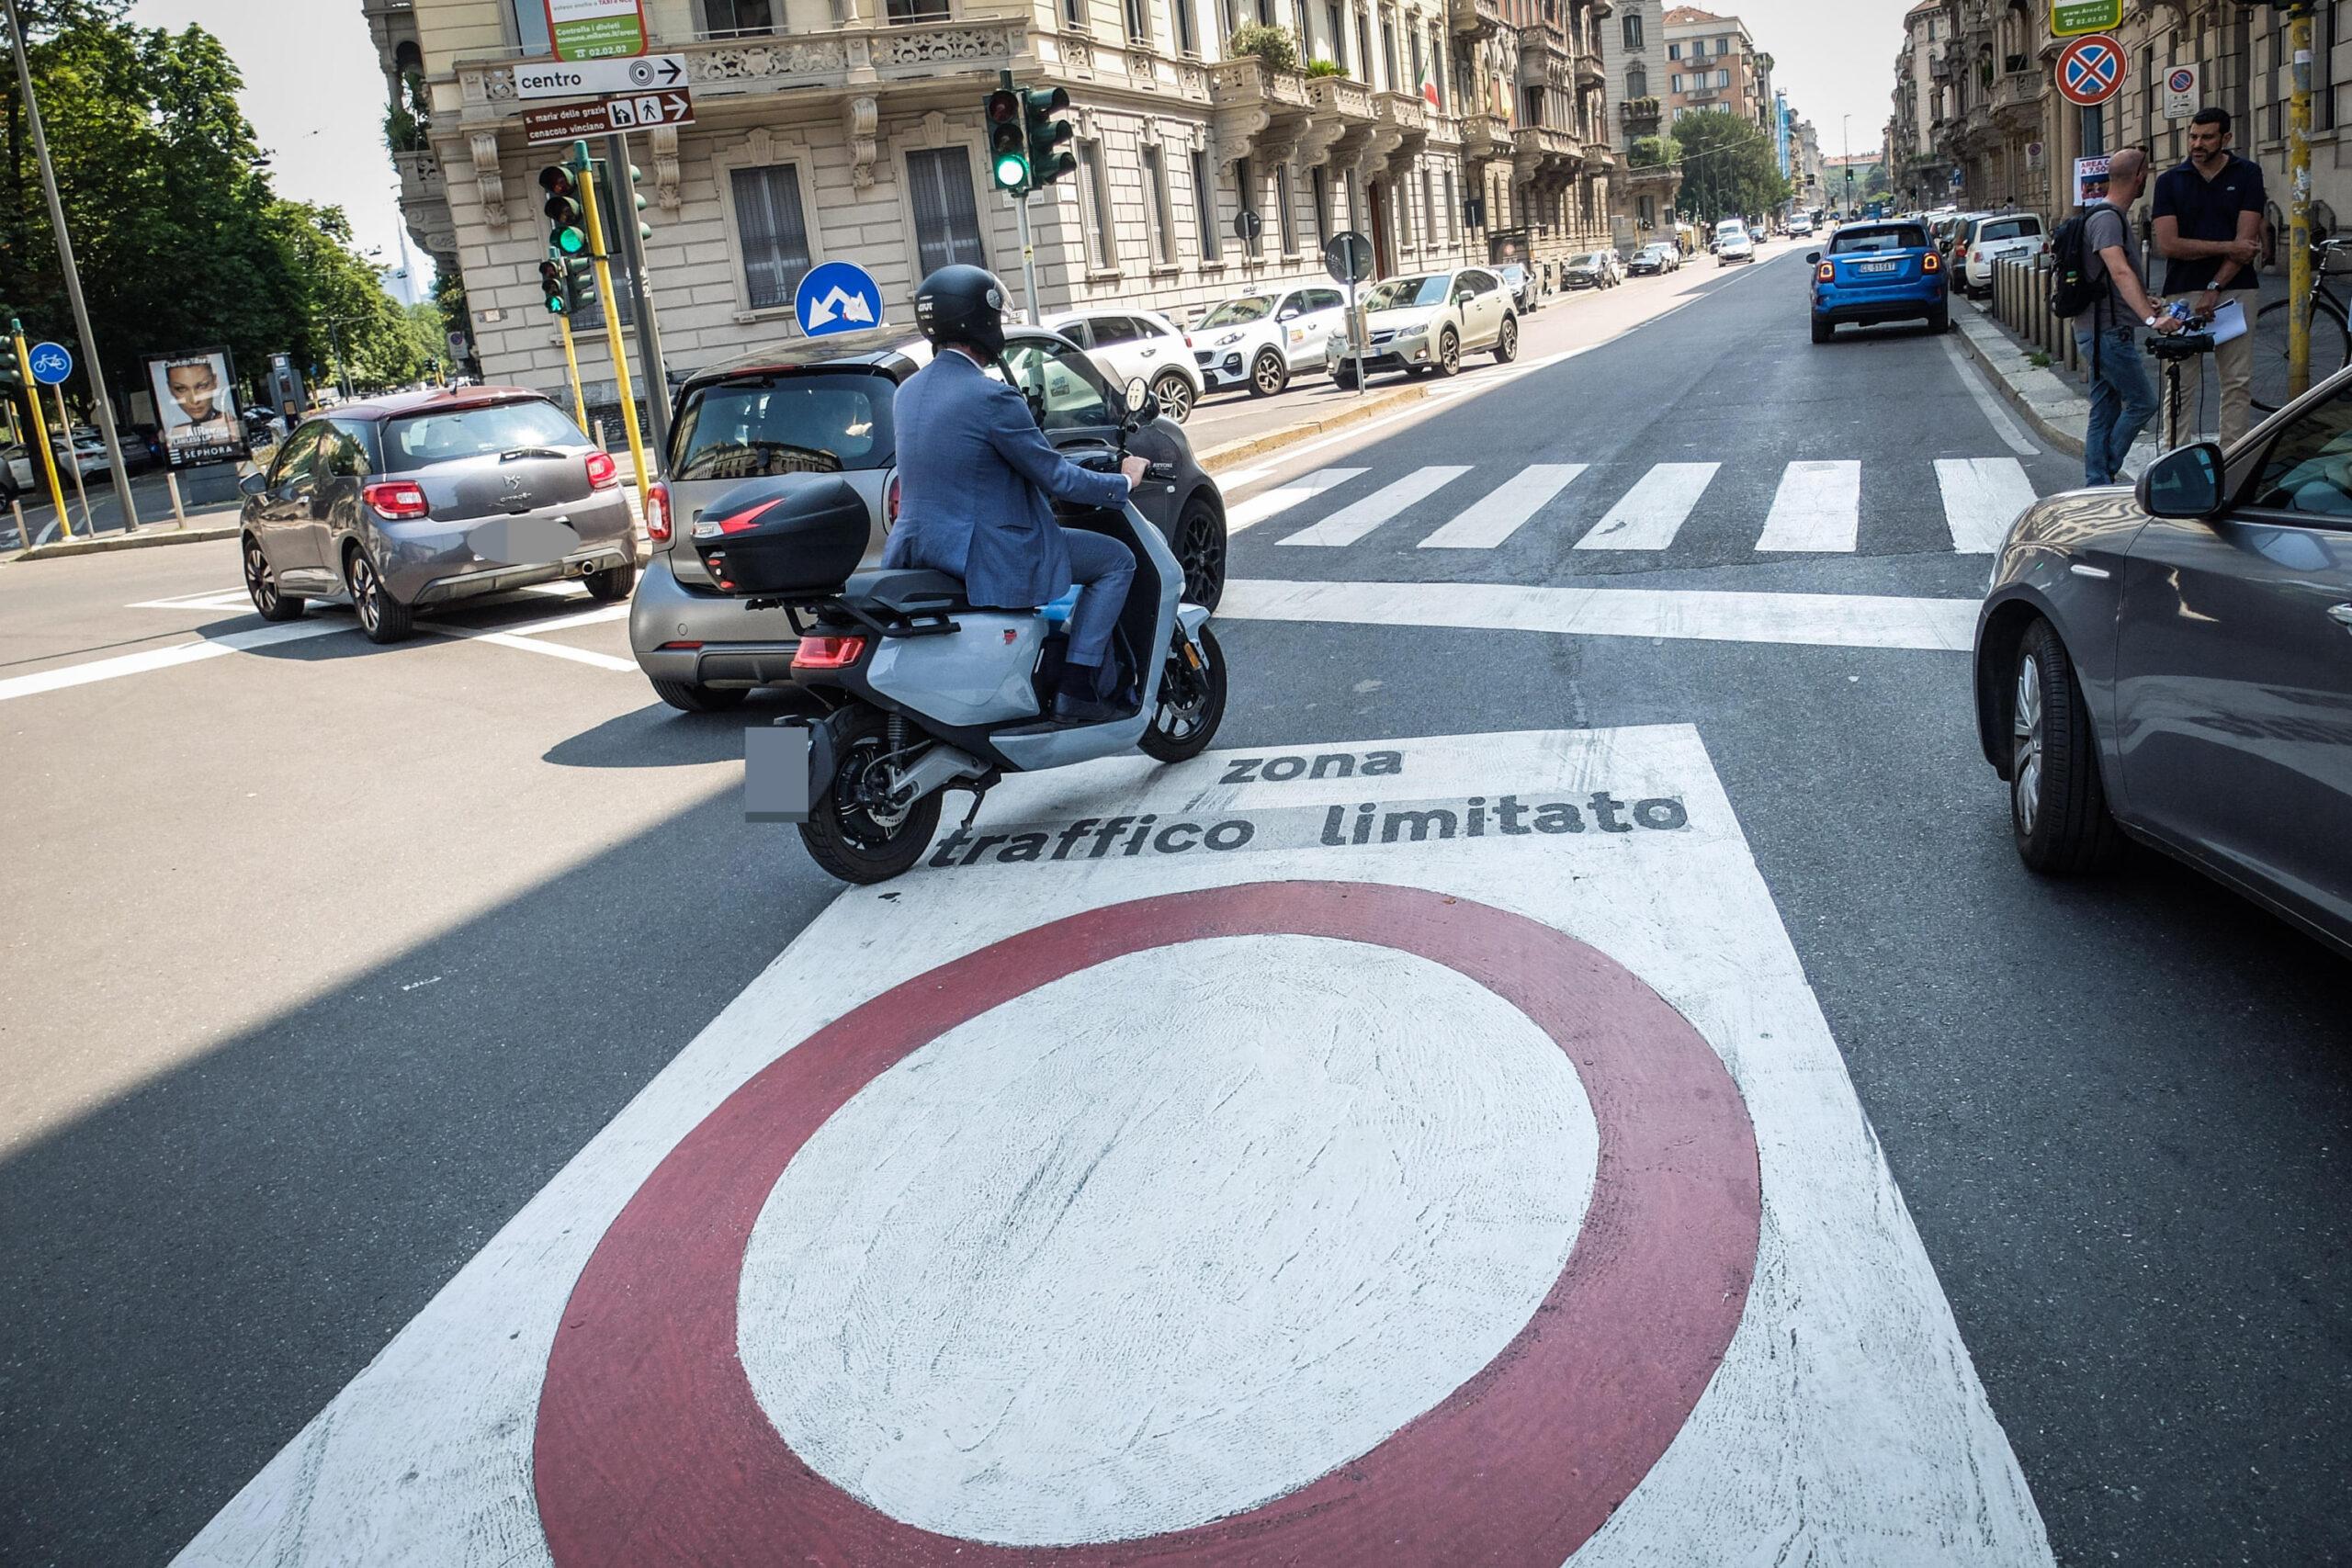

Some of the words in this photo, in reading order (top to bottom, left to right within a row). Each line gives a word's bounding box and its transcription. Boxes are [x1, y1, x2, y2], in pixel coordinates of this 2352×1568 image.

[556, 26, 590, 36] Controlla
[595, 22, 620, 31] divieti
[589, 45, 627, 56] 02.02.02
[521, 72, 582, 89] centro
[536, 112, 558, 123] maria
[560, 108, 581, 120] delle
[582, 106, 606, 118] grazie
[529, 127, 567, 139] cenacolo
[570, 121, 605, 133] vinciano
[2081, 160, 2102, 168] AREA
[185, 446, 232, 458] SEPHORA
[1218, 750, 1402, 784] zona
[928, 814, 1255, 868] traffico
[1320, 791, 1688, 847] limitato
